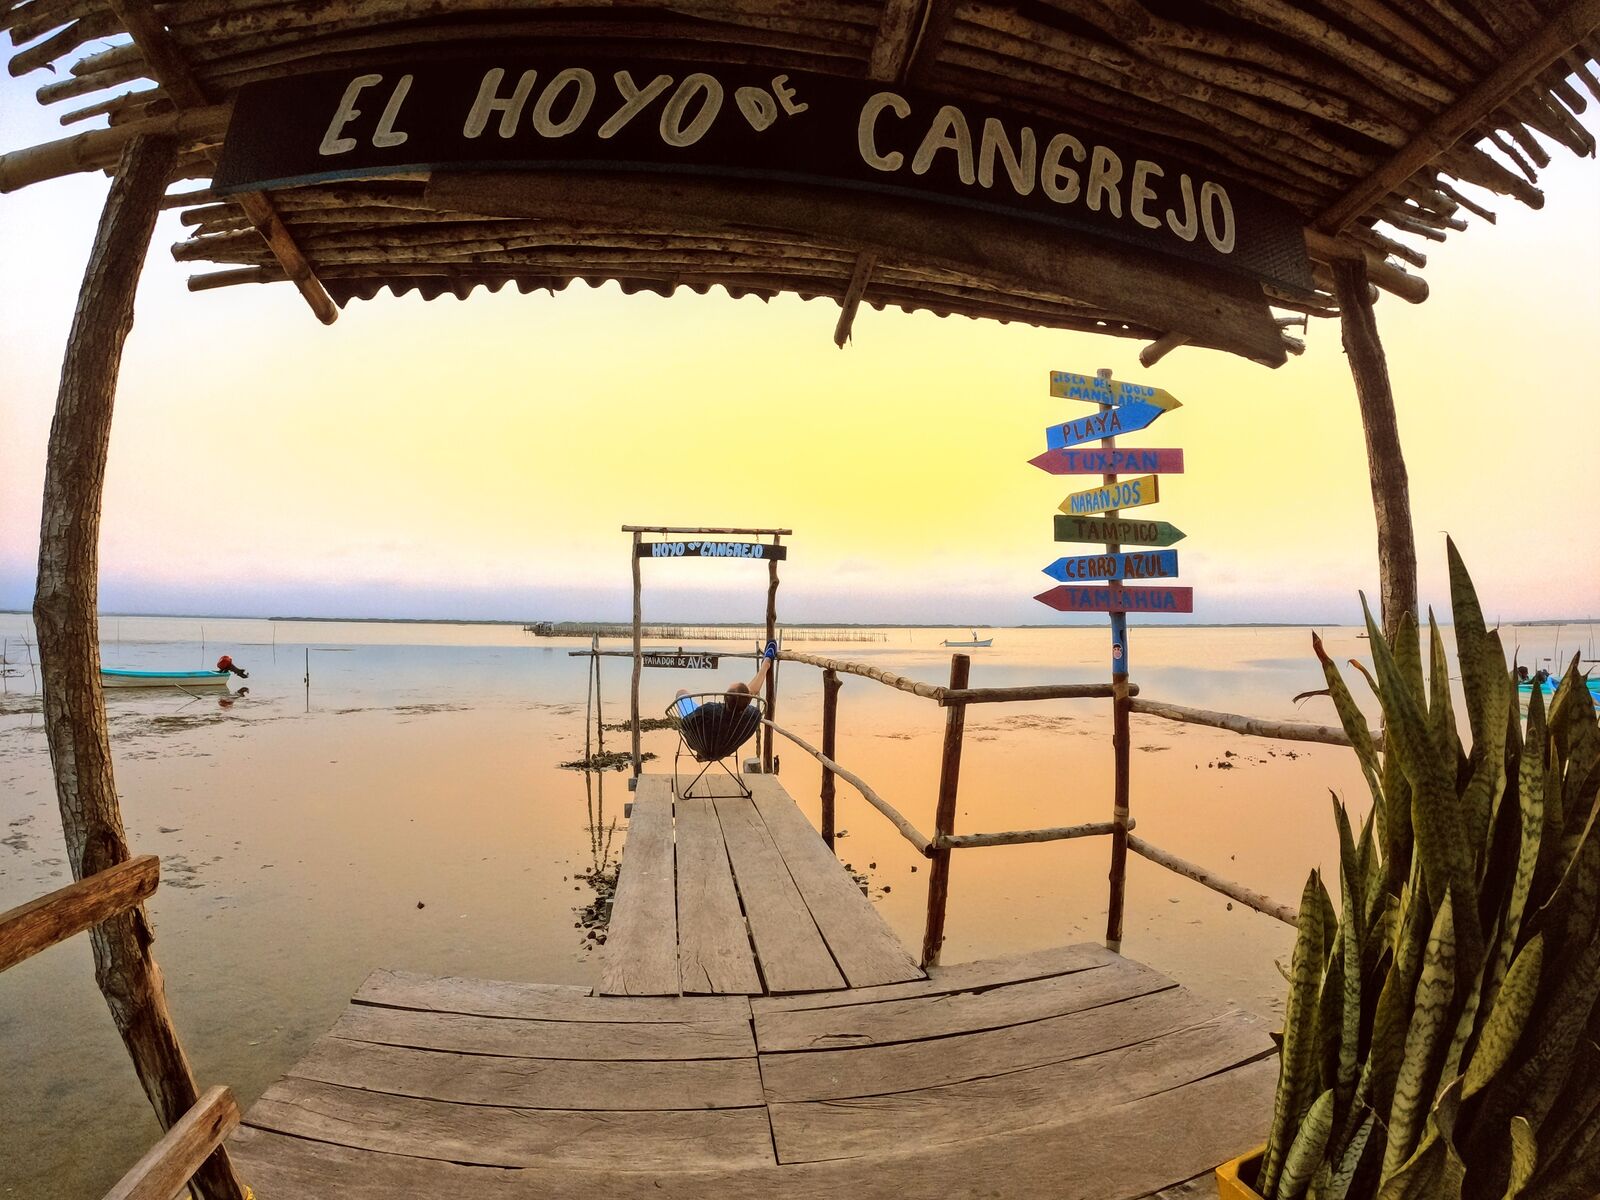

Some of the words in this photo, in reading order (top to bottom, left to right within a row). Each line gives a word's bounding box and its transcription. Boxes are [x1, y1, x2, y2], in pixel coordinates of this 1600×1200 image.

[318, 74, 413, 156] EL
[462, 68, 724, 147] HOYO
[734, 74, 809, 132] DE
[857, 91, 1236, 254] CANGREJO
[1093, 377, 1110, 389] DEL
[1121, 383, 1154, 396] IDOLO
[1062, 410, 1122, 443] PLAYA
[1062, 451, 1158, 471] TUXPAN
[1071, 481, 1141, 513] NARANJOS
[1072, 519, 1158, 542] TAMPICO
[652, 542, 685, 557] HOYO
[700, 541, 763, 558] CANGREJO
[1066, 557, 1116, 579] CERRO
[1124, 554, 1168, 577] AZUL
[1066, 588, 1177, 609] TAMIAHUA
[644, 656, 675, 666] PARADOR
[677, 658, 686, 667] DE
[686, 656, 713, 669] AVES
